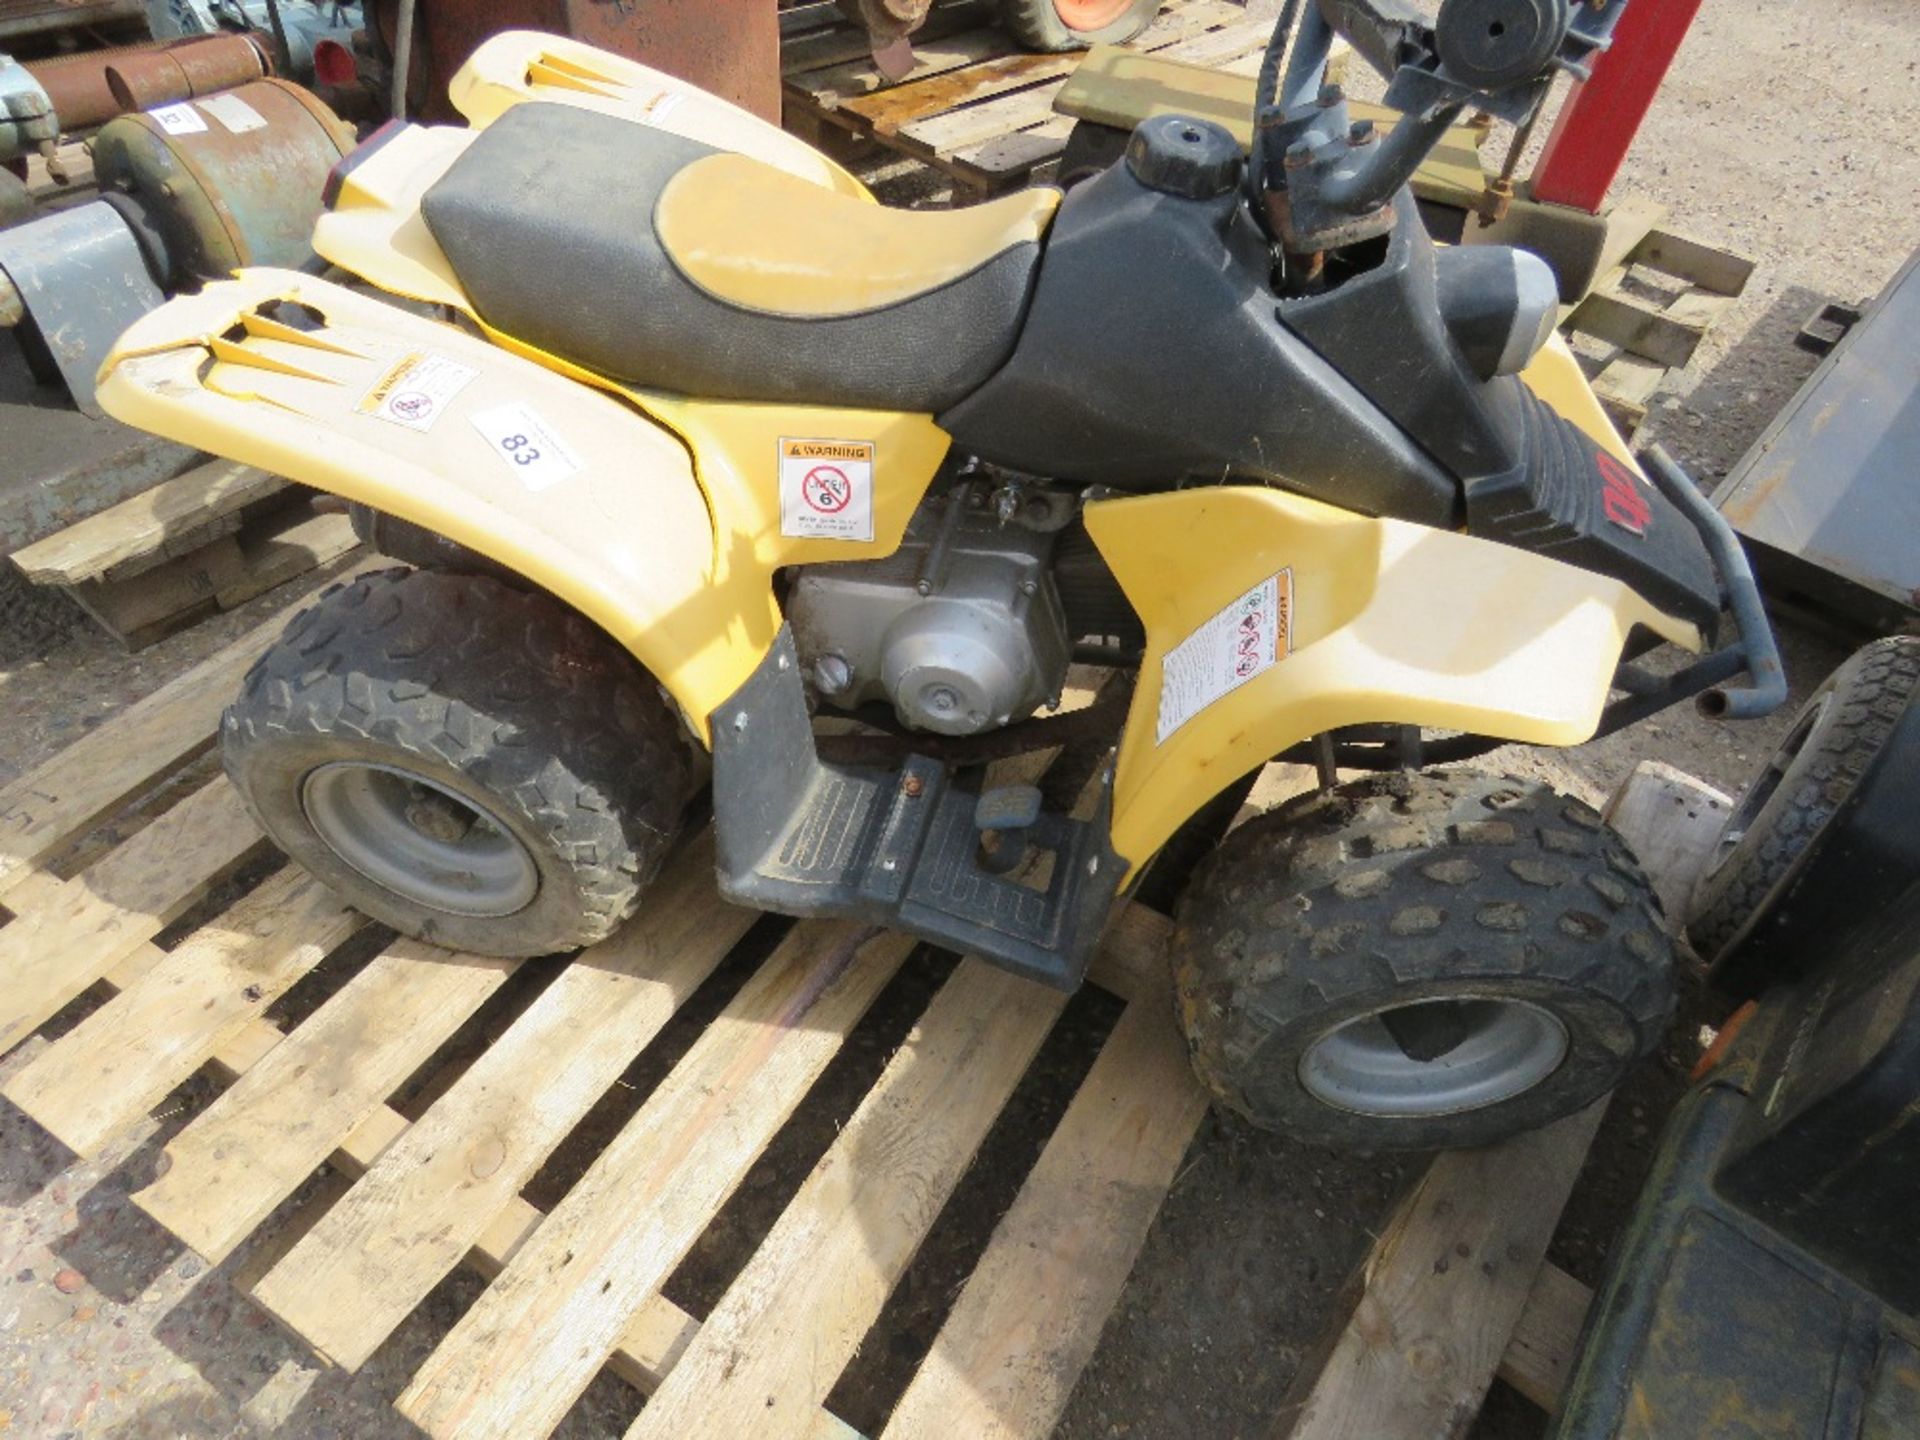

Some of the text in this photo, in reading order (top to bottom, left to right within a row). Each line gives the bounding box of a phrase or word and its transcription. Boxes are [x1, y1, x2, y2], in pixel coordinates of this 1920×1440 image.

[502, 434, 540, 466] 83
[804, 446, 865, 458] WARNING
[819, 493, 832, 505] 6
